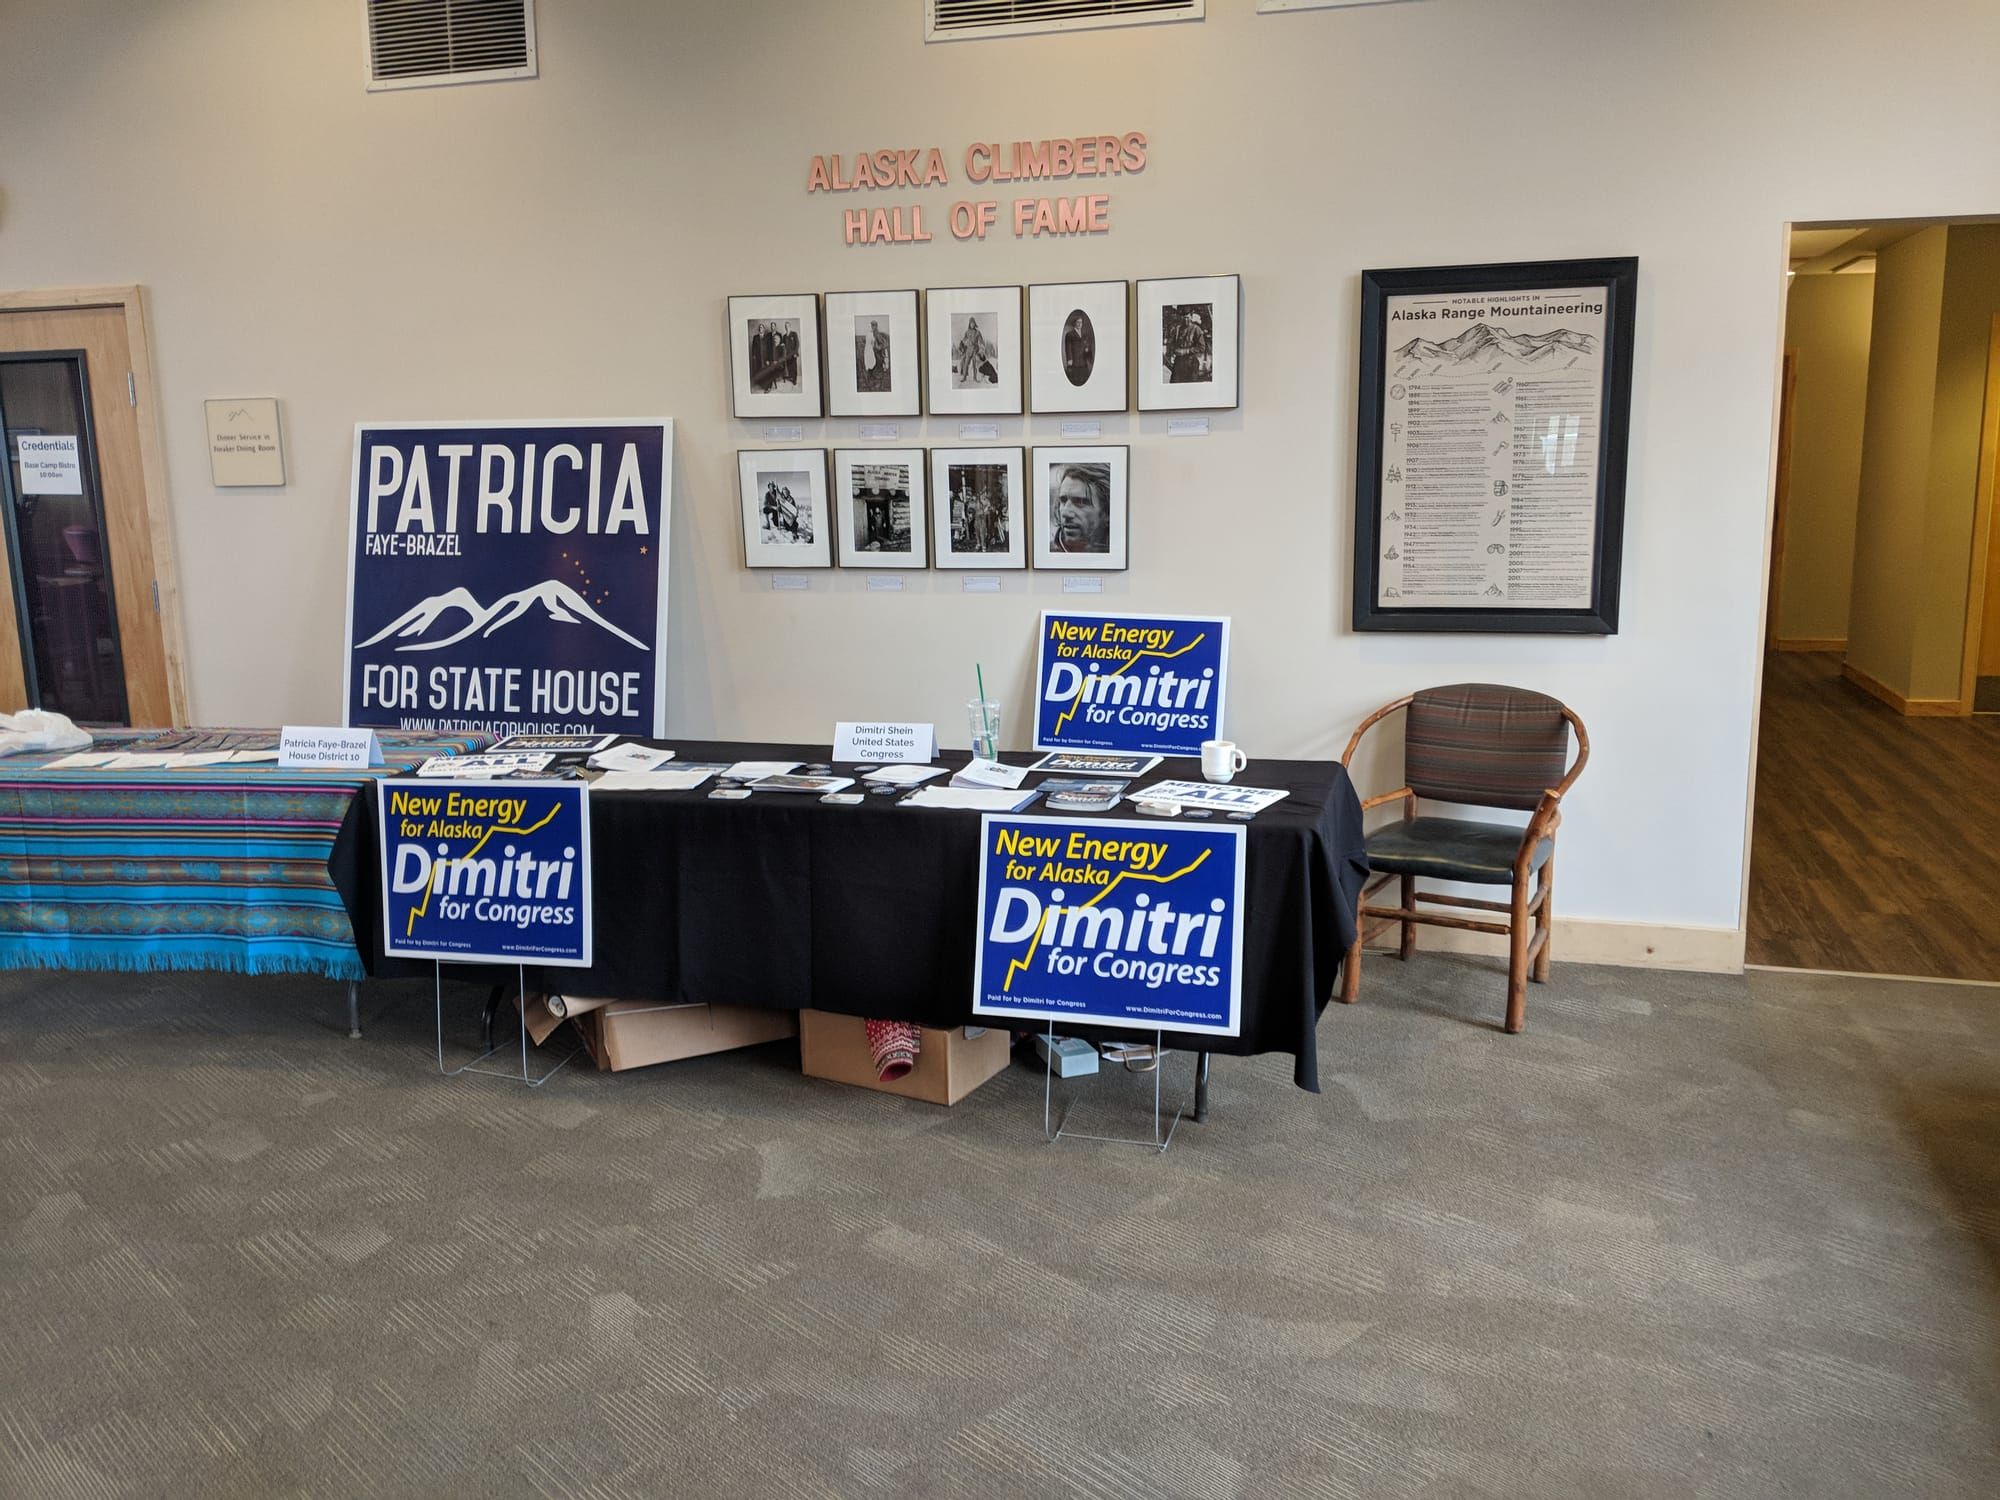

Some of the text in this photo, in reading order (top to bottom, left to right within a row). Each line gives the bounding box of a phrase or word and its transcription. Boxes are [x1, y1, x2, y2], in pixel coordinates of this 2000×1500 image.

[807, 131, 1147, 193] ALASKA CLIMBERS
[844, 194, 1110, 244] HALL OF FAME
[1392, 302, 1603, 321] Alaska Range Mountaineering
[22, 440, 74, 450] Credentials
[366, 443, 650, 535] PATRICIA
[365, 534, 462, 556] FAYE-BRAZEL
[1050, 620, 1174, 650] New Energy
[1057, 643, 1132, 660] for Alaska
[362, 664, 641, 717] FOR STATE HOUSE
[1044, 662, 1214, 710] Dimitri
[400, 717, 594, 737] WWWPATRICIAFORHOUSECOM
[855, 726, 913, 735] Dimitri Shein
[1085, 704, 1209, 731] for Congress
[284, 739, 367, 750] Patricia Faye-Brazel
[852, 737, 914, 746] United States
[860, 749, 904, 759] Congress
[288, 751, 316, 760] House
[319, 752, 348, 760] District
[390, 791, 527, 824] New Energy
[400, 818, 483, 839] for Alaska
[995, 828, 1168, 871] New Energy
[392, 842, 576, 900] Dimitri
[1005, 859, 1110, 885] for Alaska
[439, 895, 574, 929] for Congress
[988, 887, 1226, 957] Dimitri
[1046, 947, 1221, 989] for Congress
[1057, 1000, 1086, 1008] Congress
[1126, 1006, 1222, 1020] www.DimitriForCongress.com
